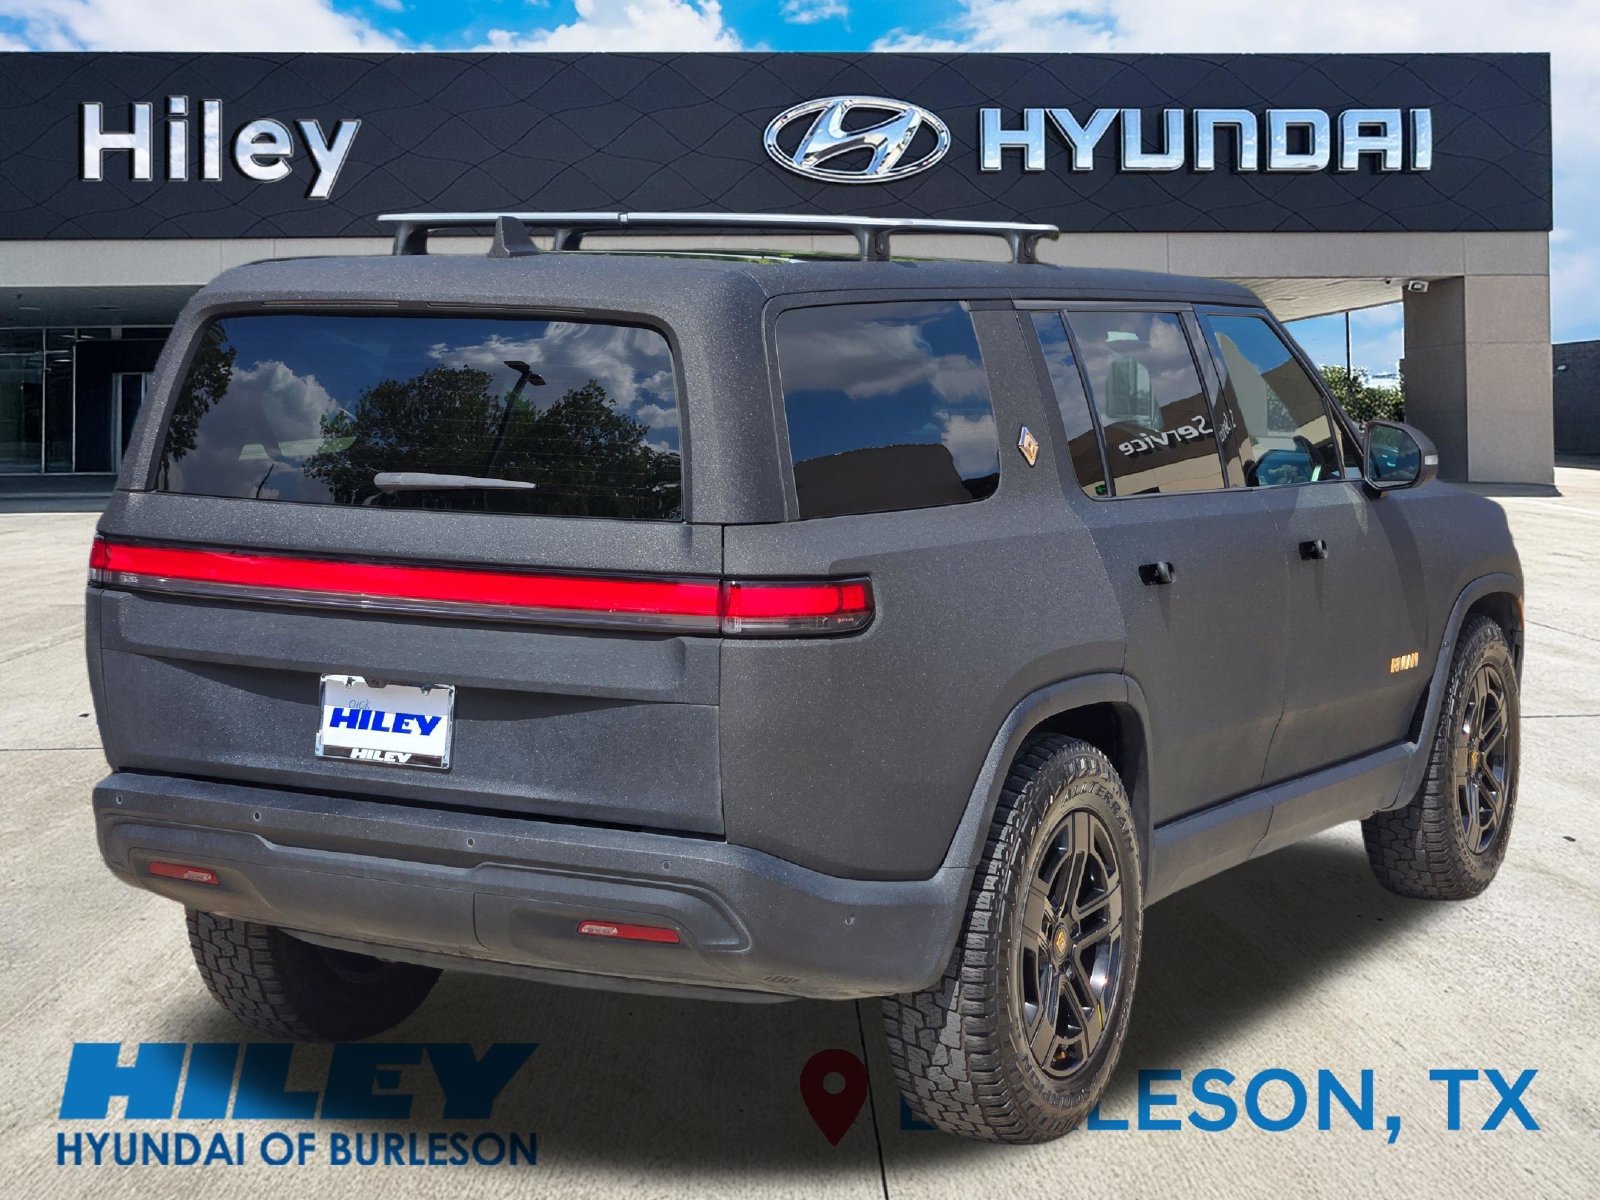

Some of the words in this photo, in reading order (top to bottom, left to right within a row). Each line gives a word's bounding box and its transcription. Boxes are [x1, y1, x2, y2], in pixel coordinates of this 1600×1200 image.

[80, 95, 362, 200] Hiley
[979, 107, 1433, 172] HYUNDAI
[329, 706, 442, 736] HILEY
[349, 747, 413, 764] HILEY
